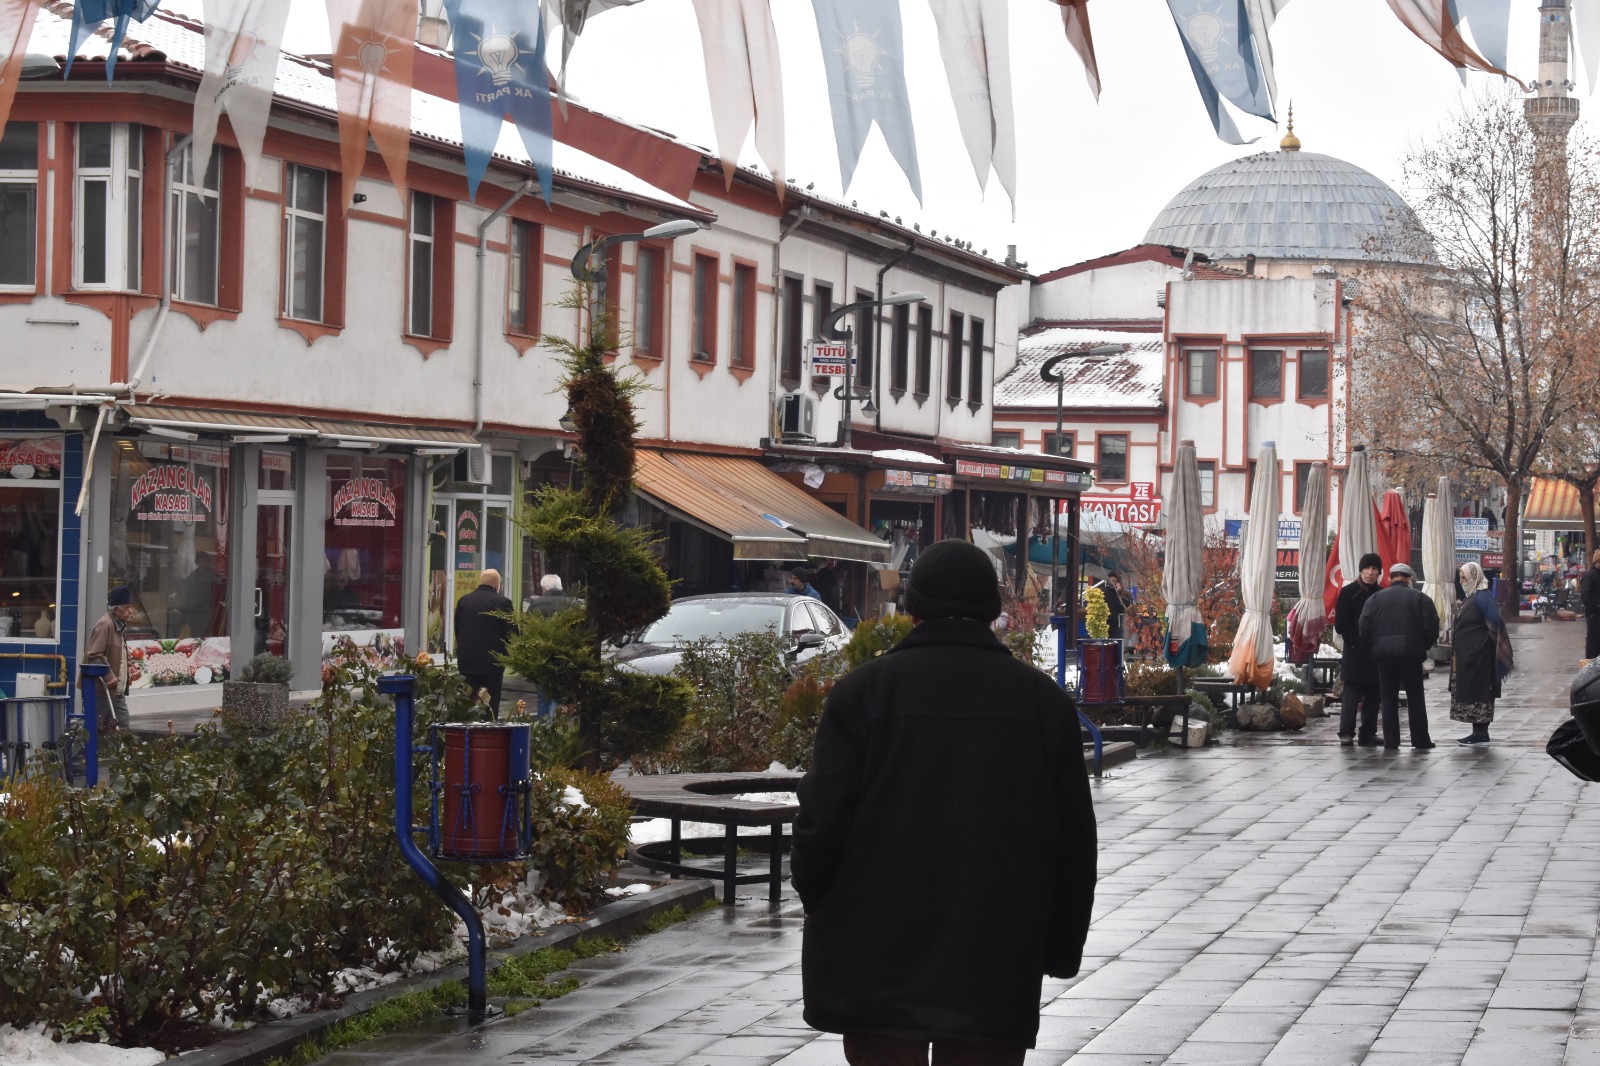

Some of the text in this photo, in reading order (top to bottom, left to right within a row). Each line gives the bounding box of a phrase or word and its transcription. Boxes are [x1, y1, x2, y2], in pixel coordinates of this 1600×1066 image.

[816, 345, 853, 357] TÜTÜ
[815, 365, 853, 375] TESBİ
[131, 465, 211, 513] KAZANCILAR
[1135, 487, 1149, 497] ZE
[155, 494, 190, 511] KASABI
[334, 477, 395, 519] KAZANCILAR
[351, 501, 379, 517] KASABI
